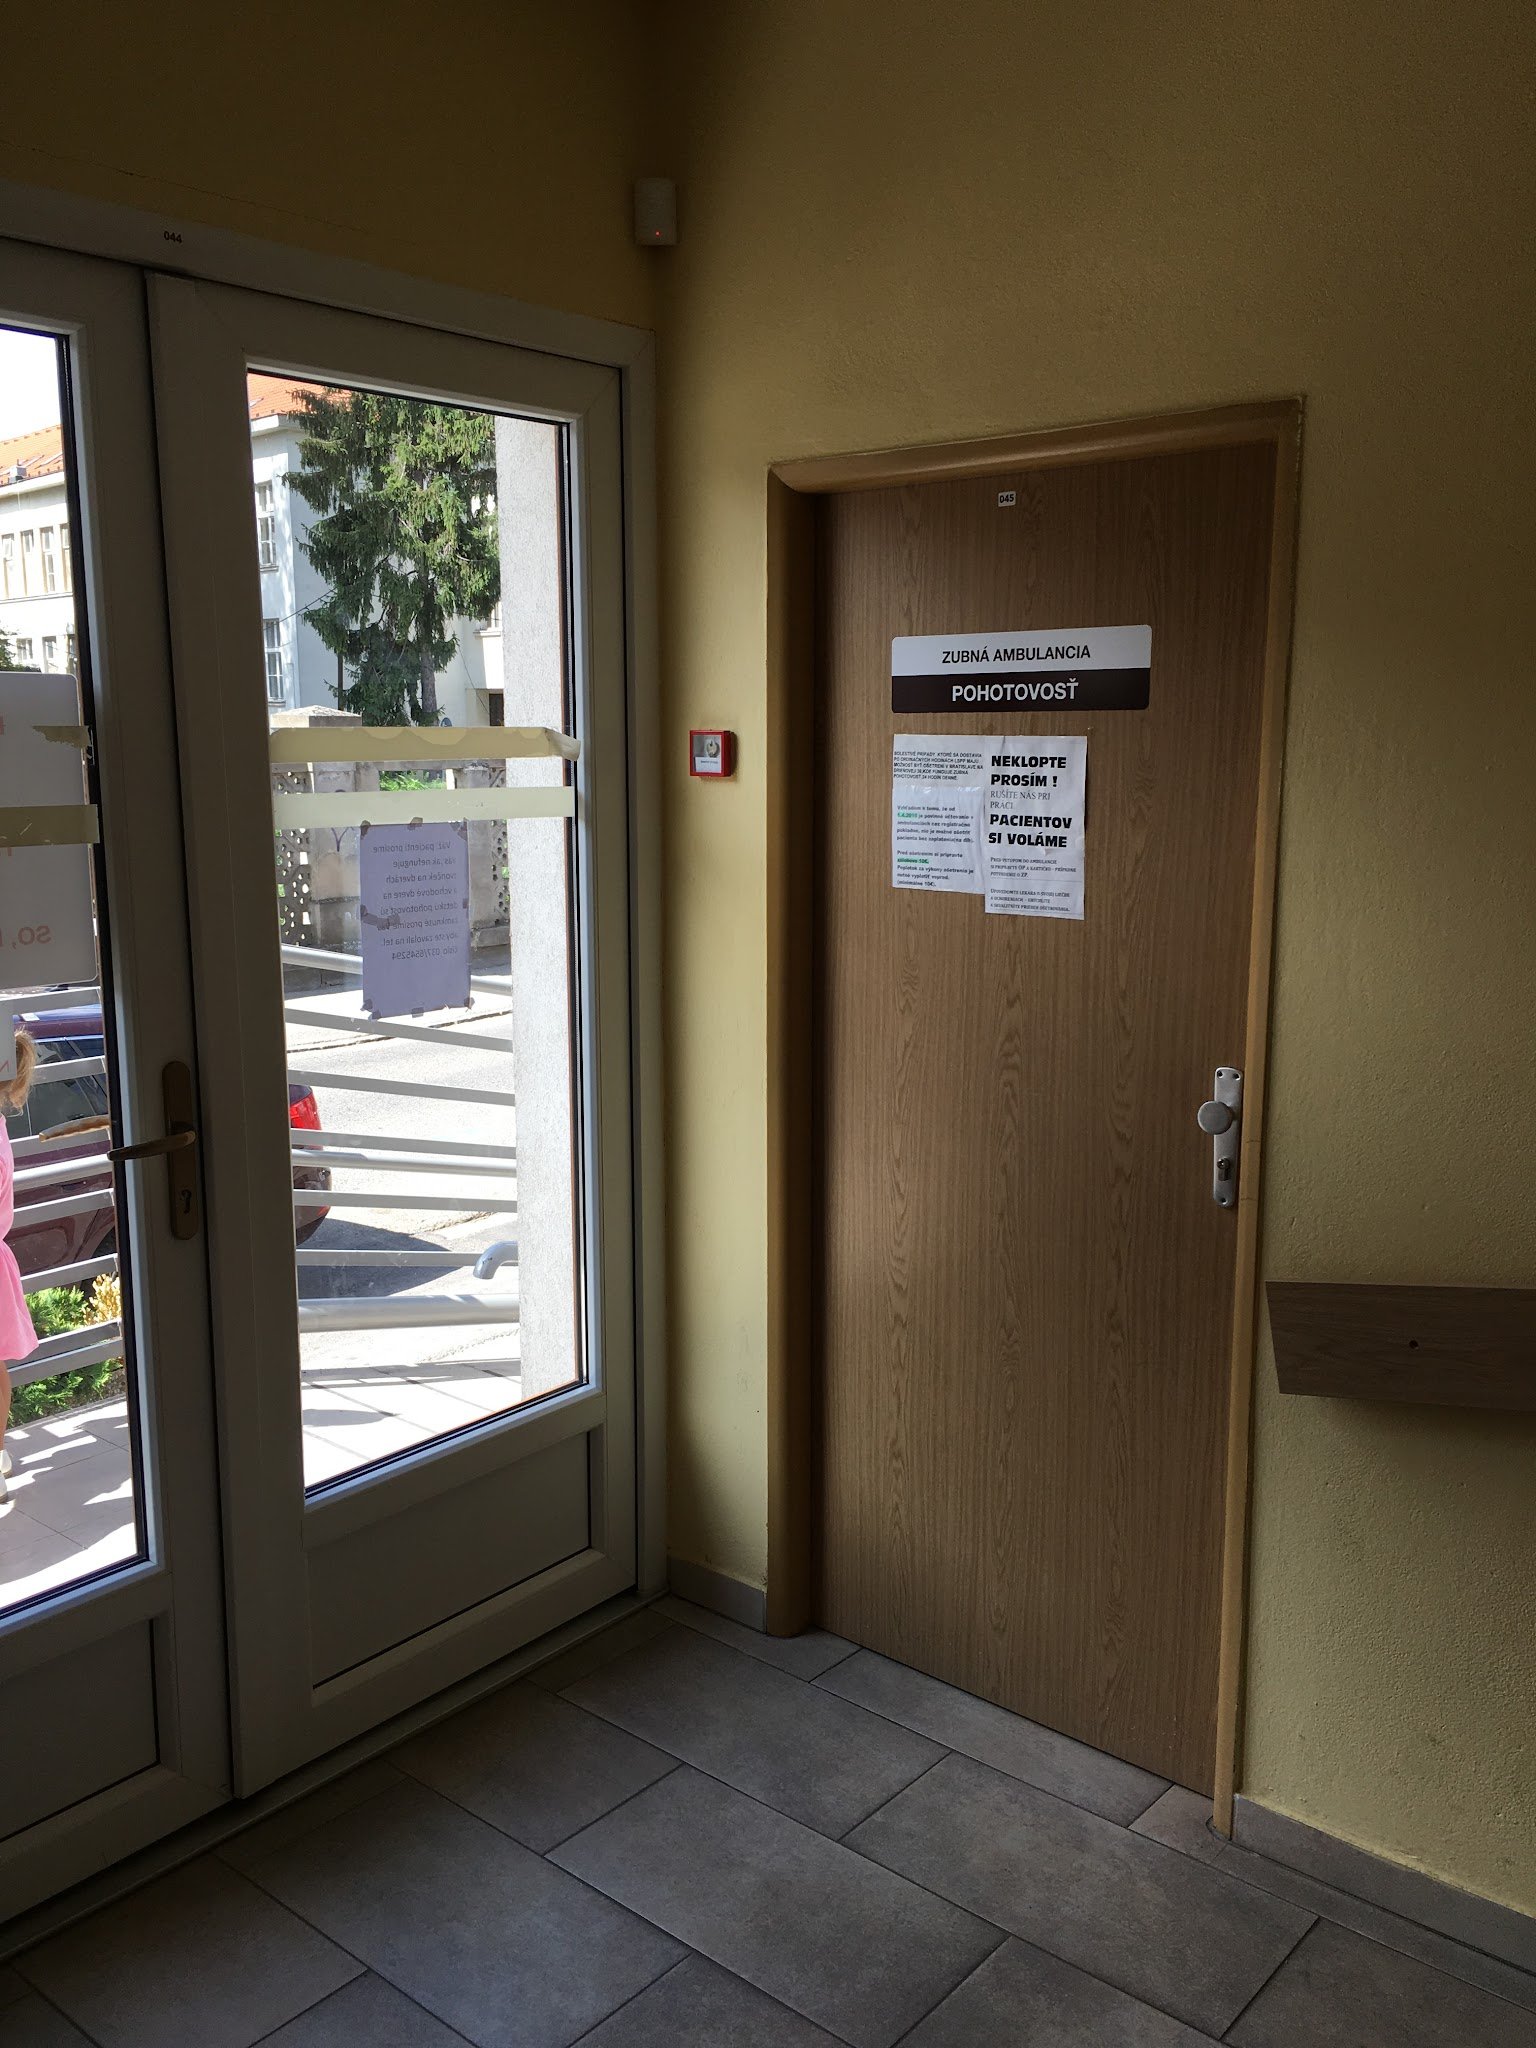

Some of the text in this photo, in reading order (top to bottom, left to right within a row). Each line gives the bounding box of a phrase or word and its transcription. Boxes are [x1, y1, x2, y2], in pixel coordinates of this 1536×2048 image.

[164, 231, 182, 243] 044
[999, 493, 1014, 503] 045
[942, 644, 1091, 664] ZUBNÁ AMBULANCIA
[952, 678, 1079, 702] POHOTOVOSŤ
[991, 755, 1067, 769] NEKLOPTE
[991, 772, 1058, 788] PROSÍM !
[990, 789, 1019, 800] RUŠÍTE
[1019, 789, 1036, 800] NÁS
[989, 814, 1072, 829] PACIENTOV
[988, 831, 1067, 848] SI VOLÁME
